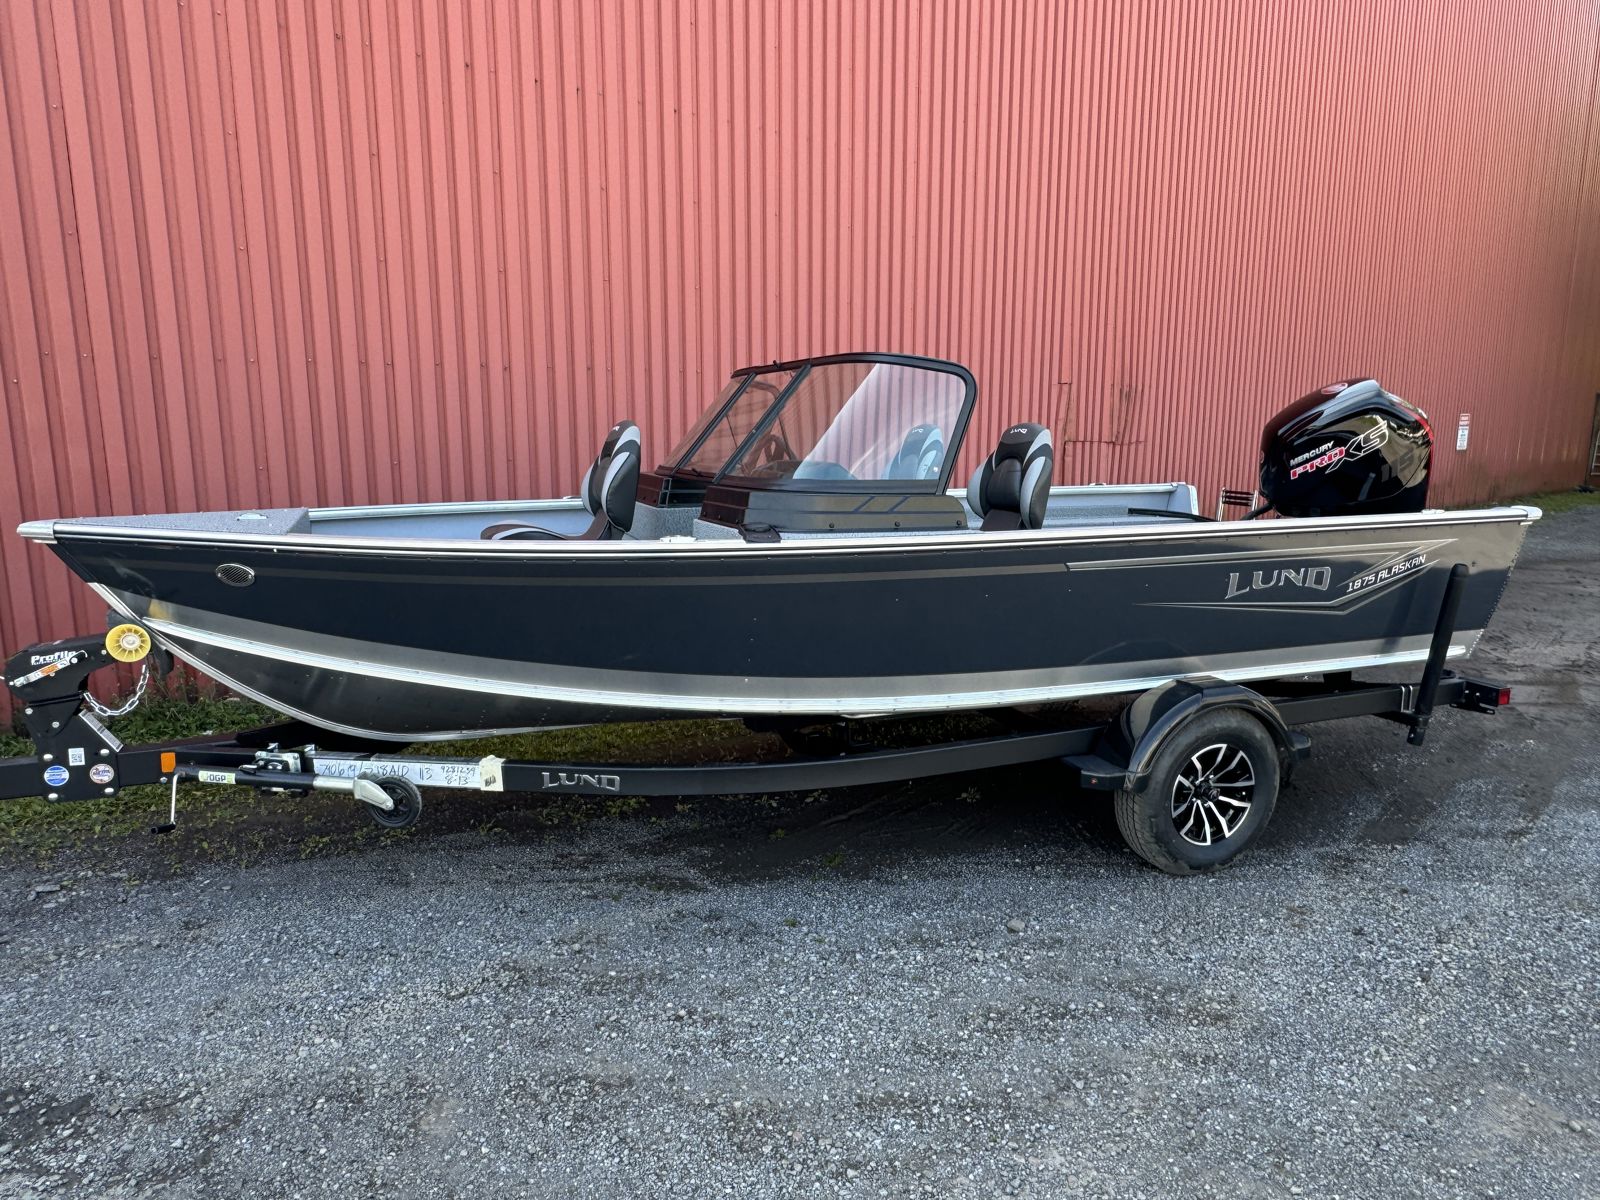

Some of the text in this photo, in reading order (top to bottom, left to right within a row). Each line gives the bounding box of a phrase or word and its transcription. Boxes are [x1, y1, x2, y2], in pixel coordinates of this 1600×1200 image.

[1290, 420, 1389, 480] PRO XS
[1290, 440, 1335, 467] MERCURY
[1225, 566, 1332, 600] LUND
[1346, 554, 1427, 593] 1875 ALASKAN
[541, 771, 620, 792] LUND
